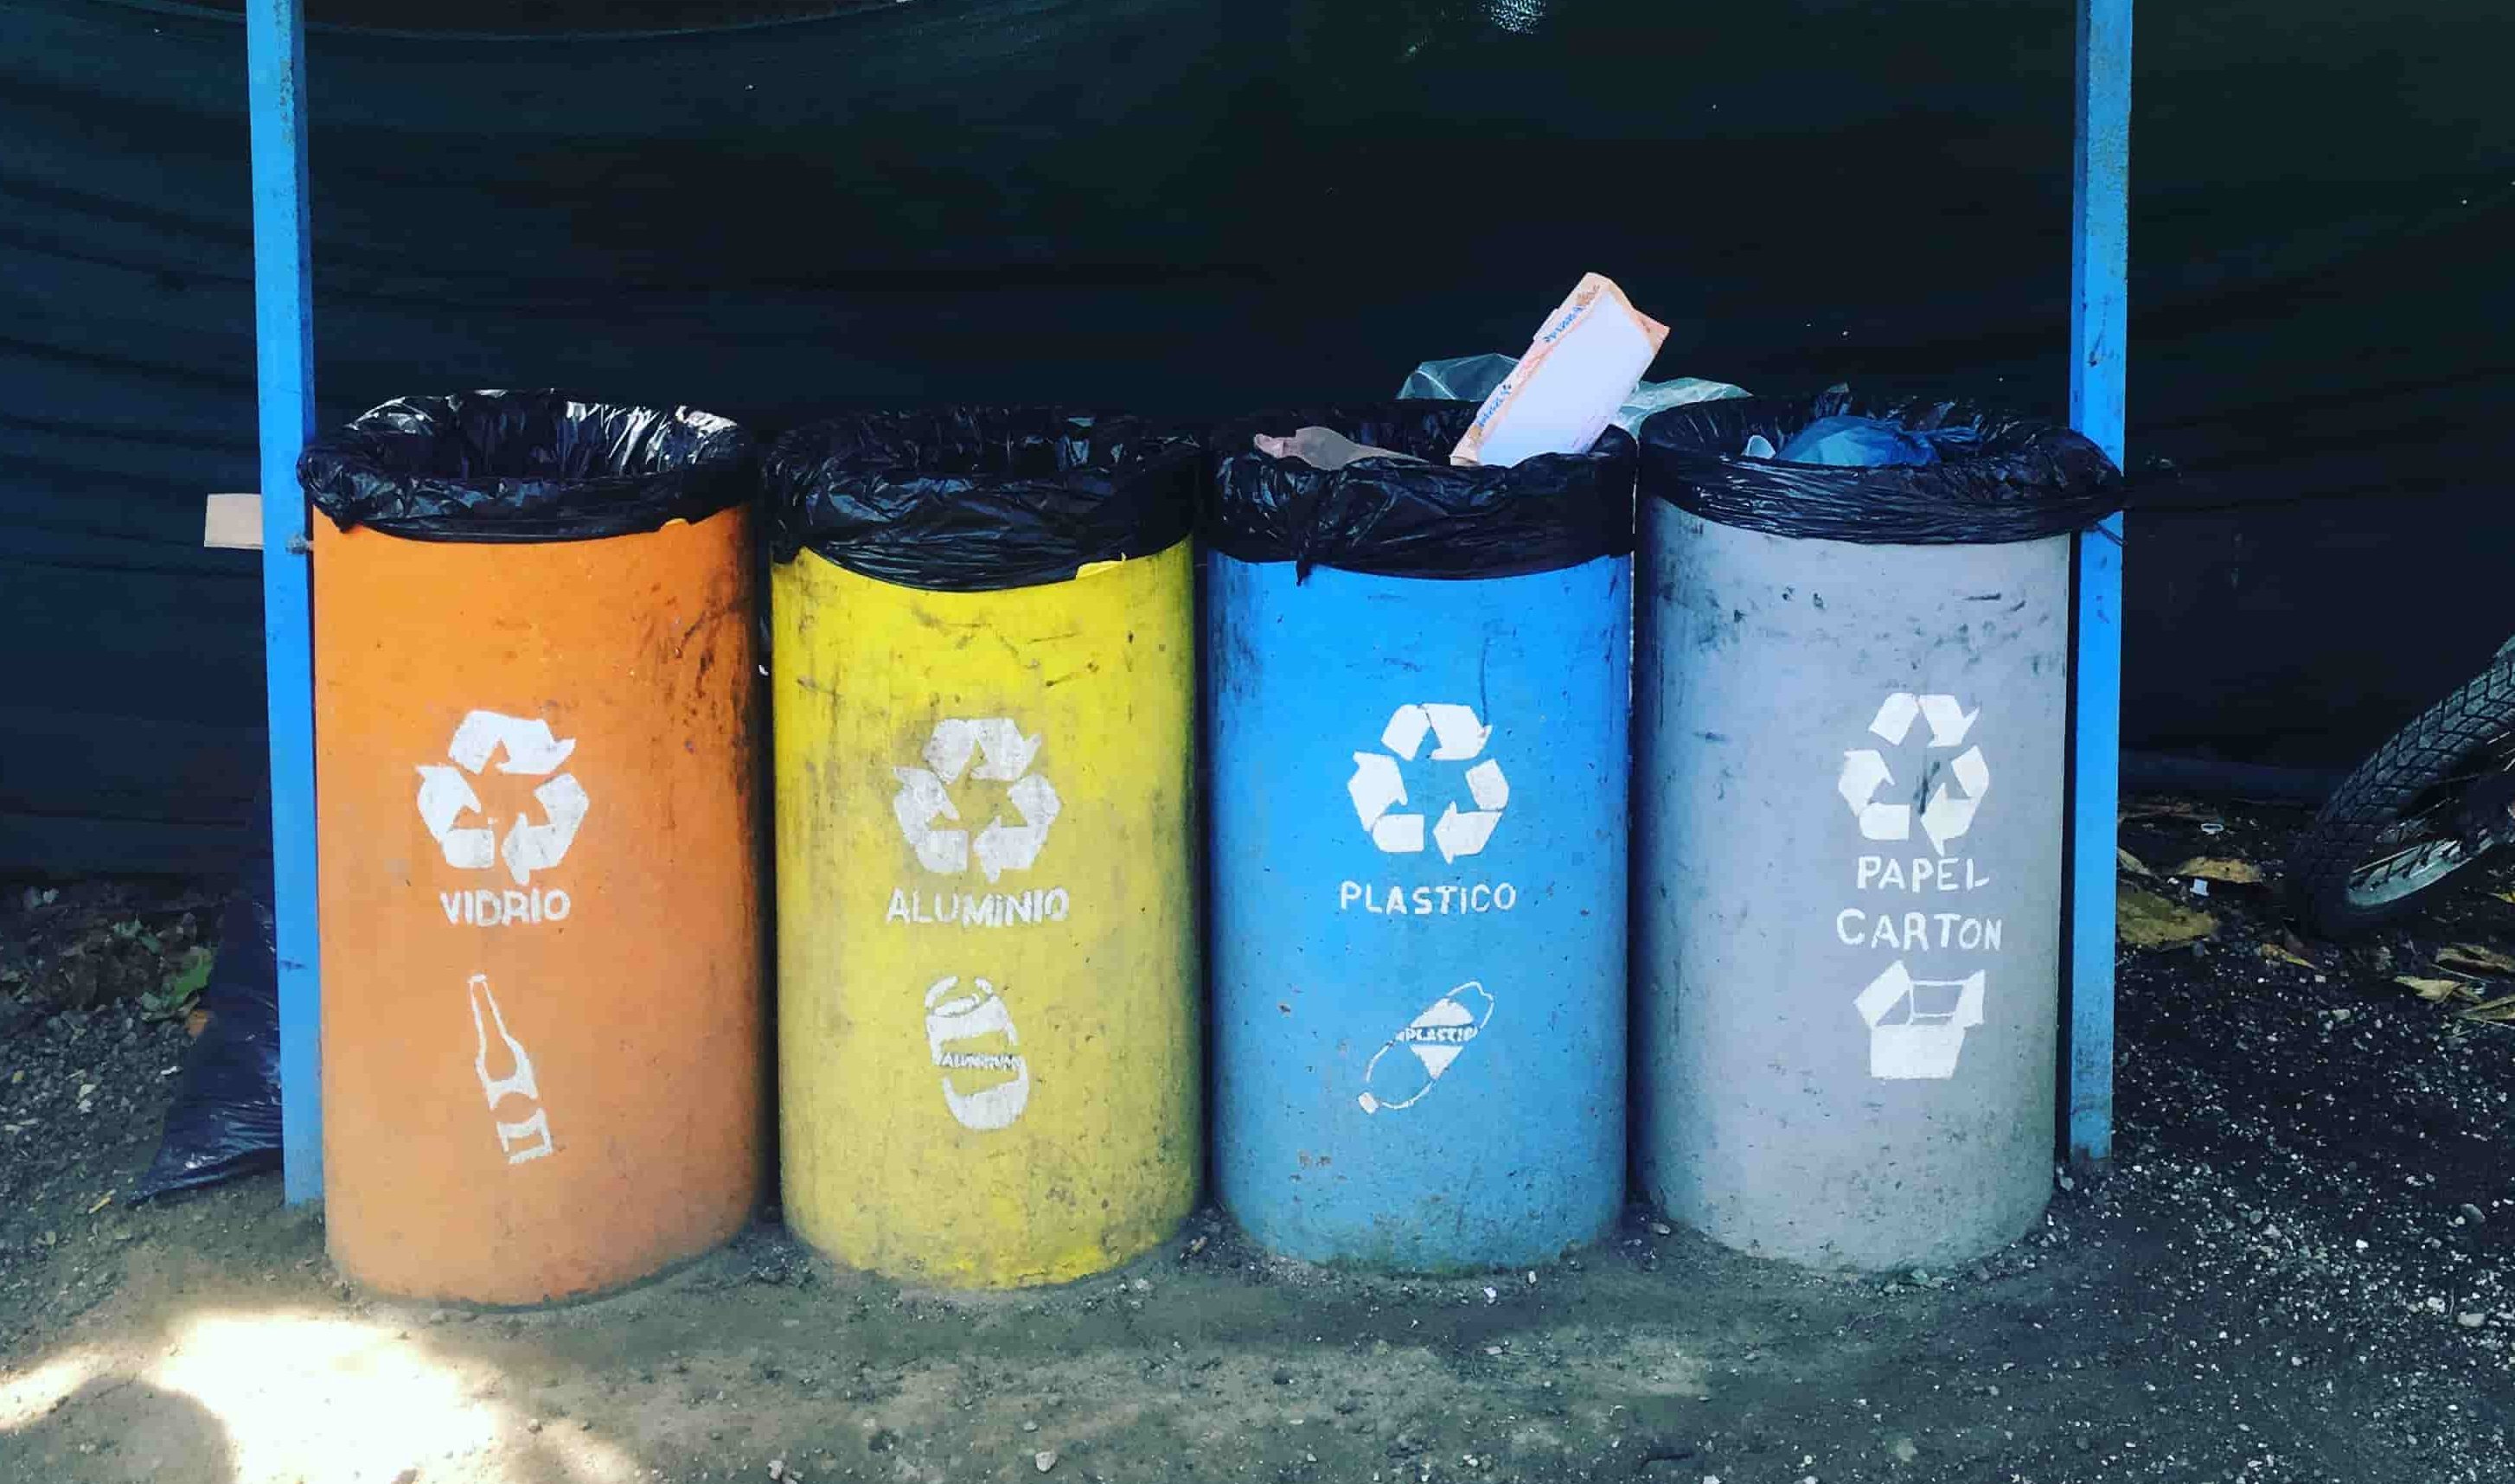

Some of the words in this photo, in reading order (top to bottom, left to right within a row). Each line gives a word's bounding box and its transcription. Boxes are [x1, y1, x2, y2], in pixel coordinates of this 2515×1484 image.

[1857, 854, 1990, 893] PAPEL
[439, 888, 571, 926] VIDRIO
[1836, 908, 2002, 951] CARTON
